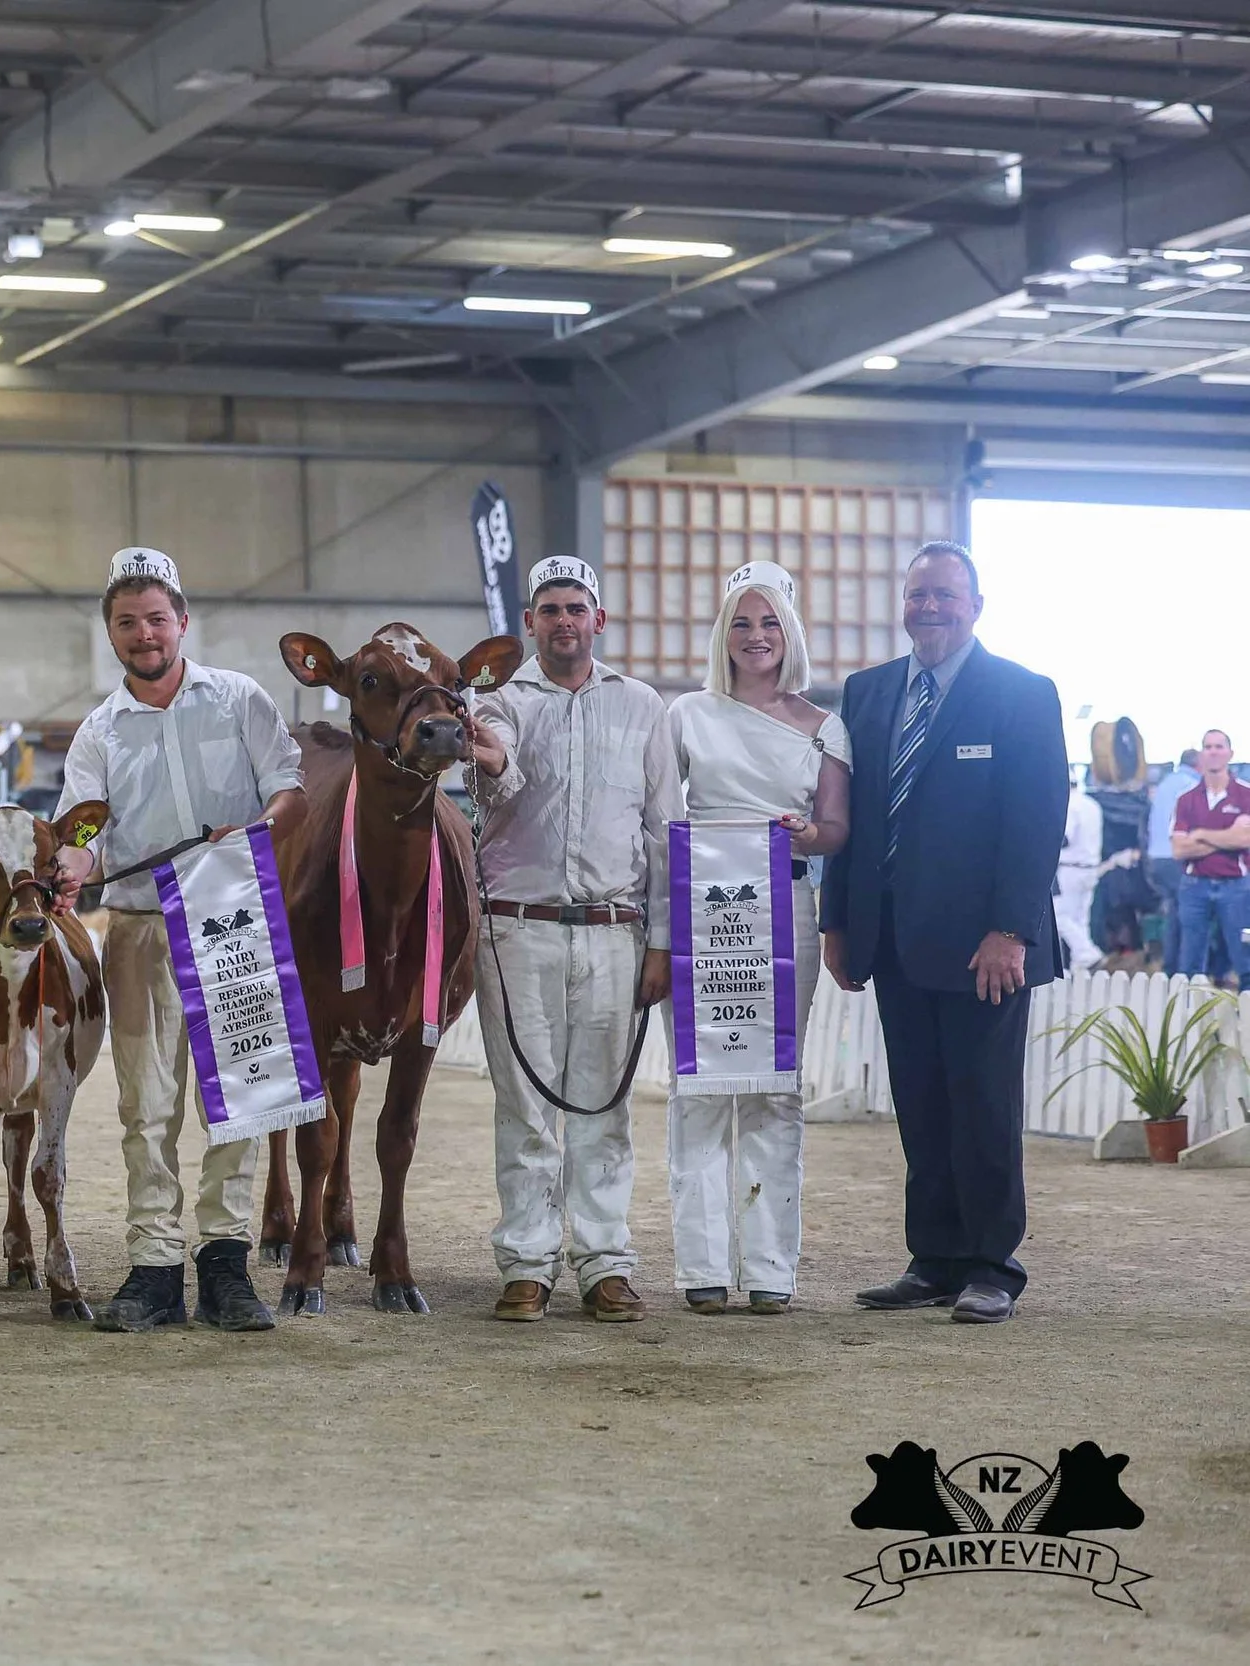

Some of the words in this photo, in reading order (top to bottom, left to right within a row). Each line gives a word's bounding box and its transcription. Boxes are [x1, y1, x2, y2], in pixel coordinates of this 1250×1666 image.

[121, 562, 160, 577] SEMEX
[537, 566, 575, 582] SEMEX
[727, 567, 751, 593] 192
[722, 913, 740, 923] NZ
[710, 924, 753, 935] DAIRY
[224, 940, 243, 954] NZ
[709, 936, 755, 948] EVENT
[215, 949, 256, 970] DAIRY
[695, 957, 769, 969] CHAMPION
[216, 961, 261, 983] EVENT
[707, 970, 758, 981] JUNIOR
[218, 980, 268, 1002] RESERVE
[700, 981, 766, 994] AYRSHIRE
[214, 989, 275, 1014] CHAMPION
[226, 1002, 266, 1022] JUNIOR
[711, 1004, 757, 1021] 2026
[221, 1011, 274, 1034] AYRSHIRE
[230, 1031, 273, 1057] 2026
[722, 1042, 748, 1051] Vytelle
[244, 1072, 270, 1086] Vytelle
